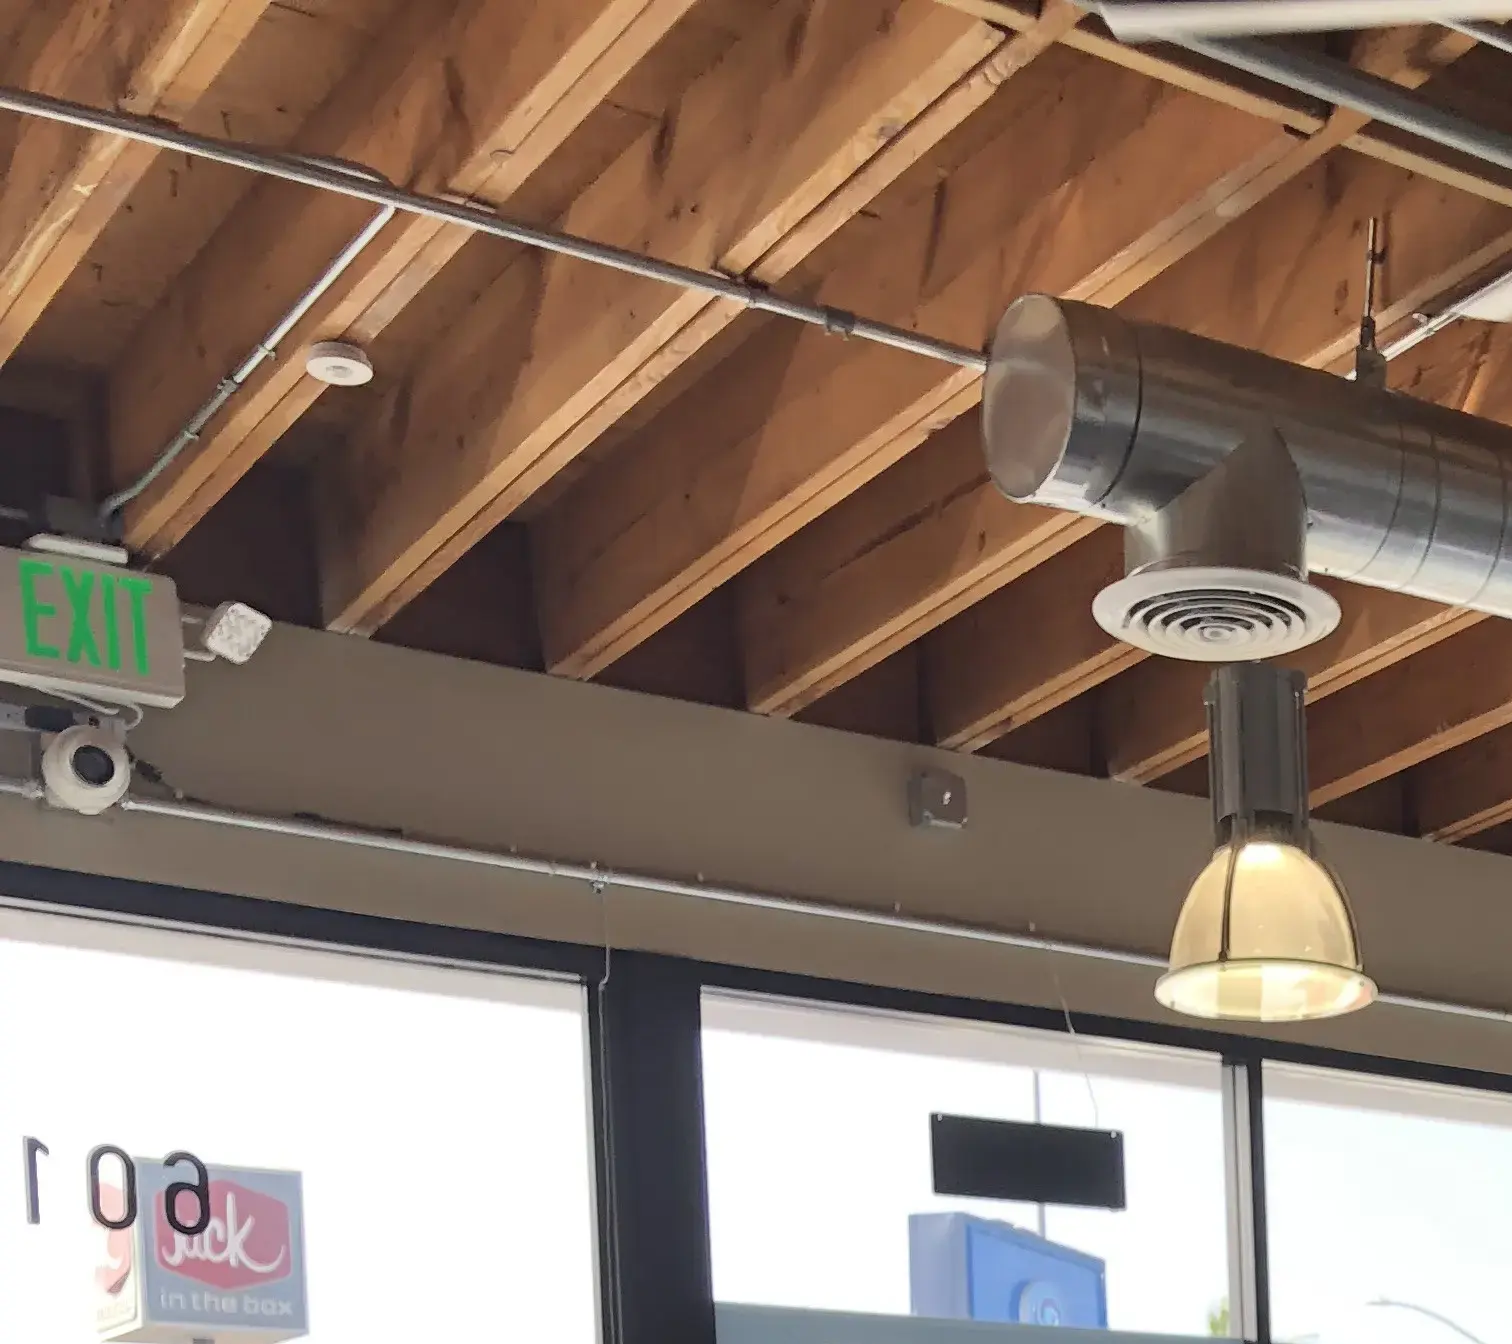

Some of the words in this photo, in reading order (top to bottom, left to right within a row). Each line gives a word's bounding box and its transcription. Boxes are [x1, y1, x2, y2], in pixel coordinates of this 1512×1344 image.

[18, 557, 154, 677] EXIT
[160, 1288, 186, 1310] in
[193, 1291, 238, 1314] the
[243, 1293, 293, 1316] box
